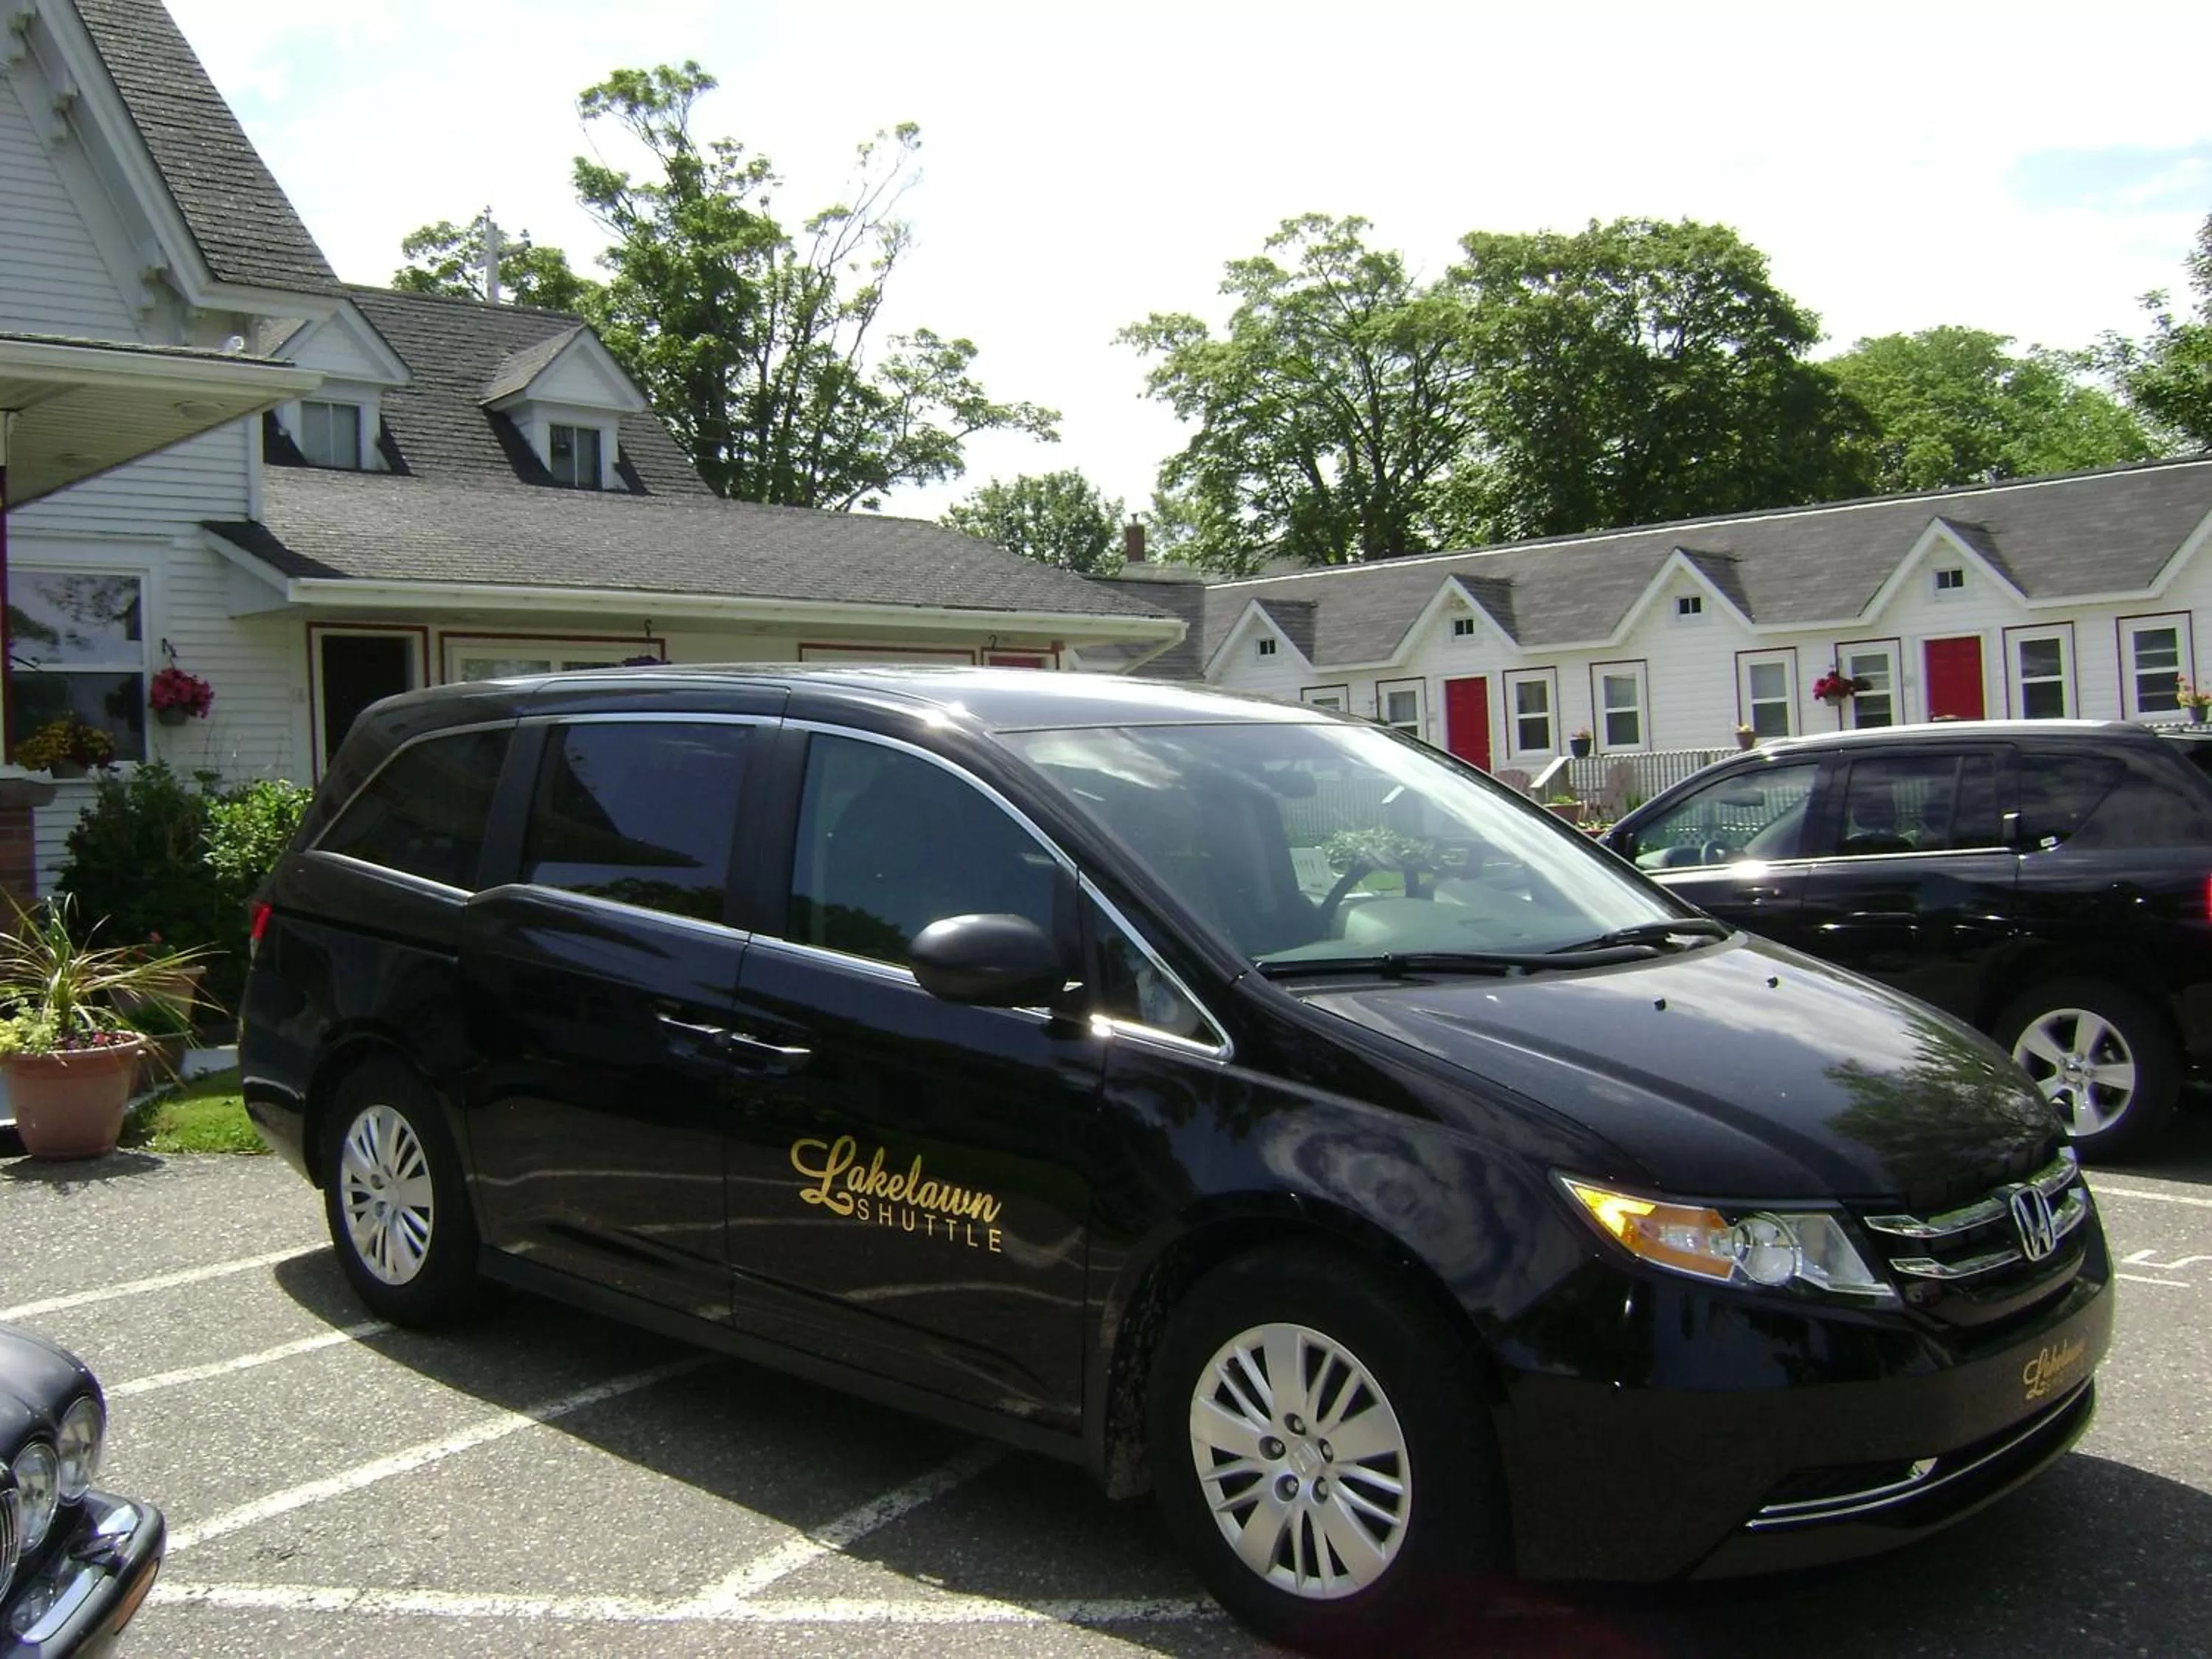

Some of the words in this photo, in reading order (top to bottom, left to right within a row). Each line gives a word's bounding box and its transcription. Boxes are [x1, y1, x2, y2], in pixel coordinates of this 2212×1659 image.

[790, 1134, 1002, 1222] Lakelawn
[856, 1197, 1003, 1253] SHUTTLE
[2023, 1338, 2086, 1399] Lakel
